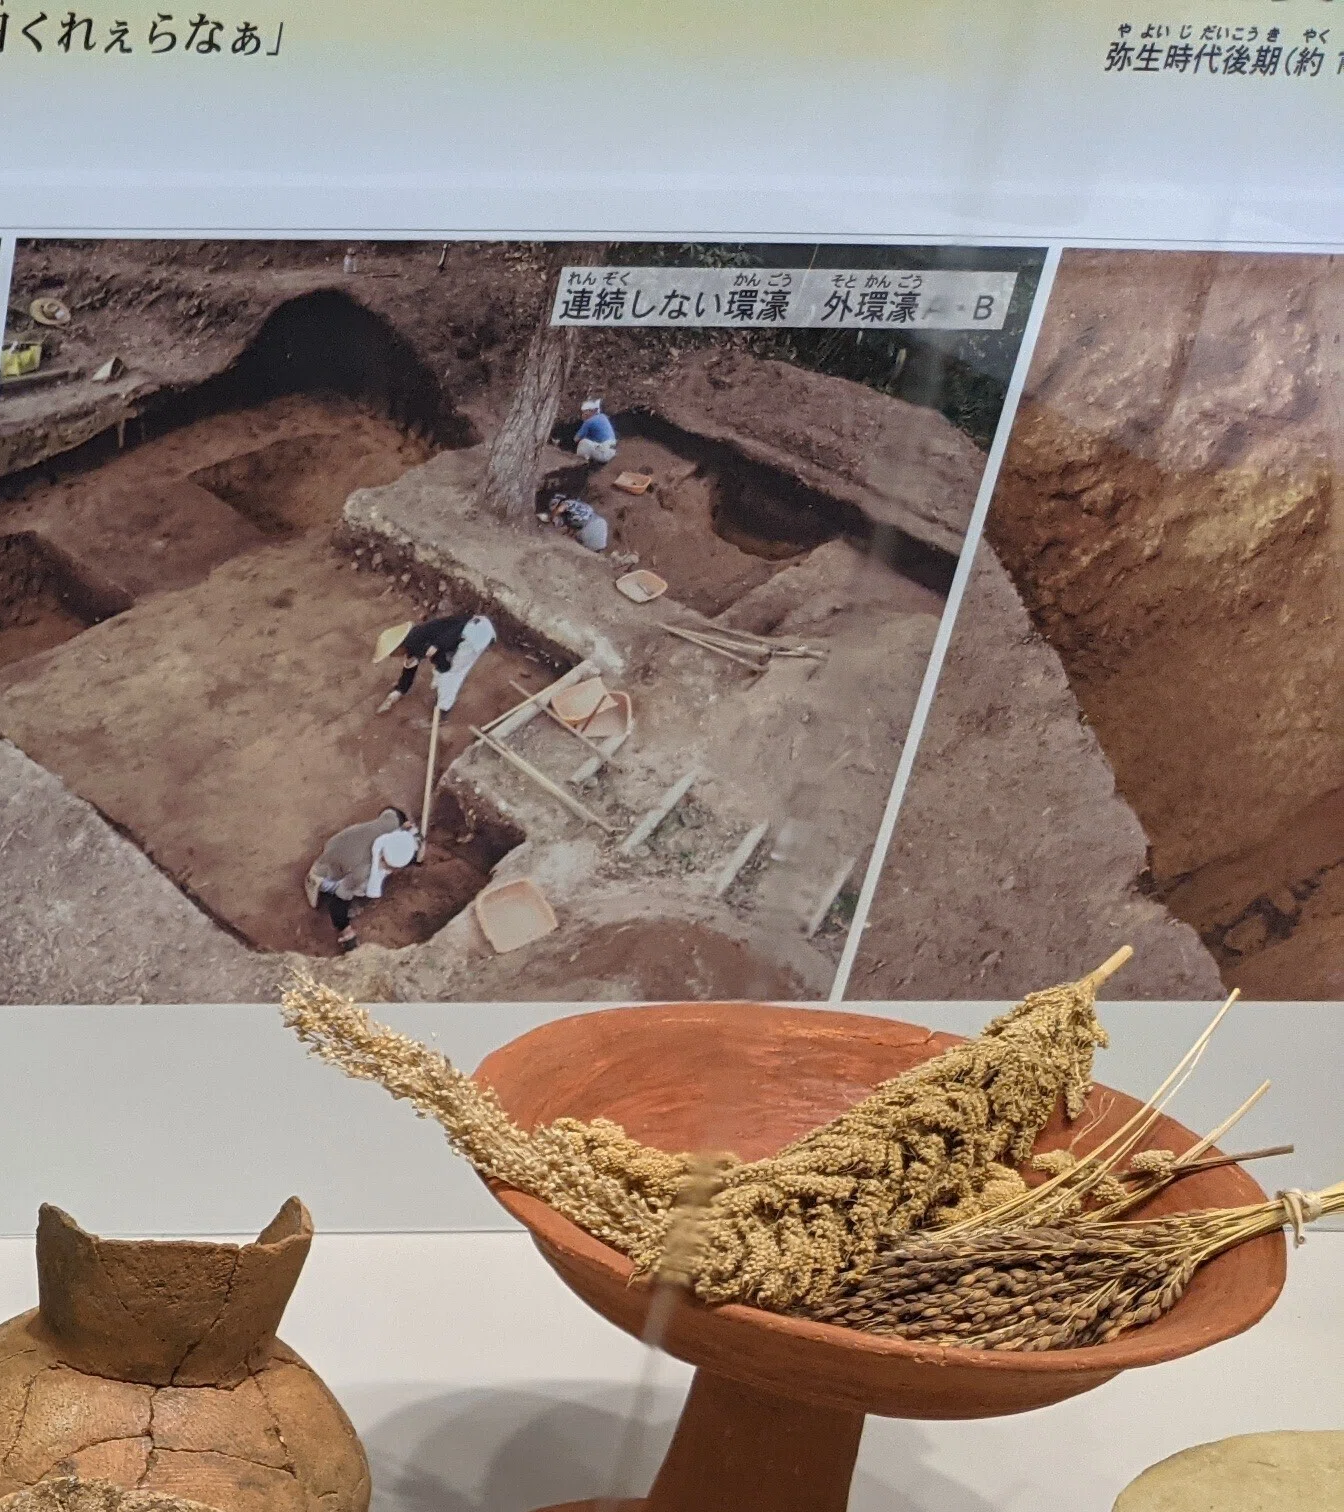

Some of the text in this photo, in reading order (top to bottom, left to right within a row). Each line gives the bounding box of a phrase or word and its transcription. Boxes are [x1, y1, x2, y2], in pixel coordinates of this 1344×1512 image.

[560, 288, 791, 321] 連続しない環濠
